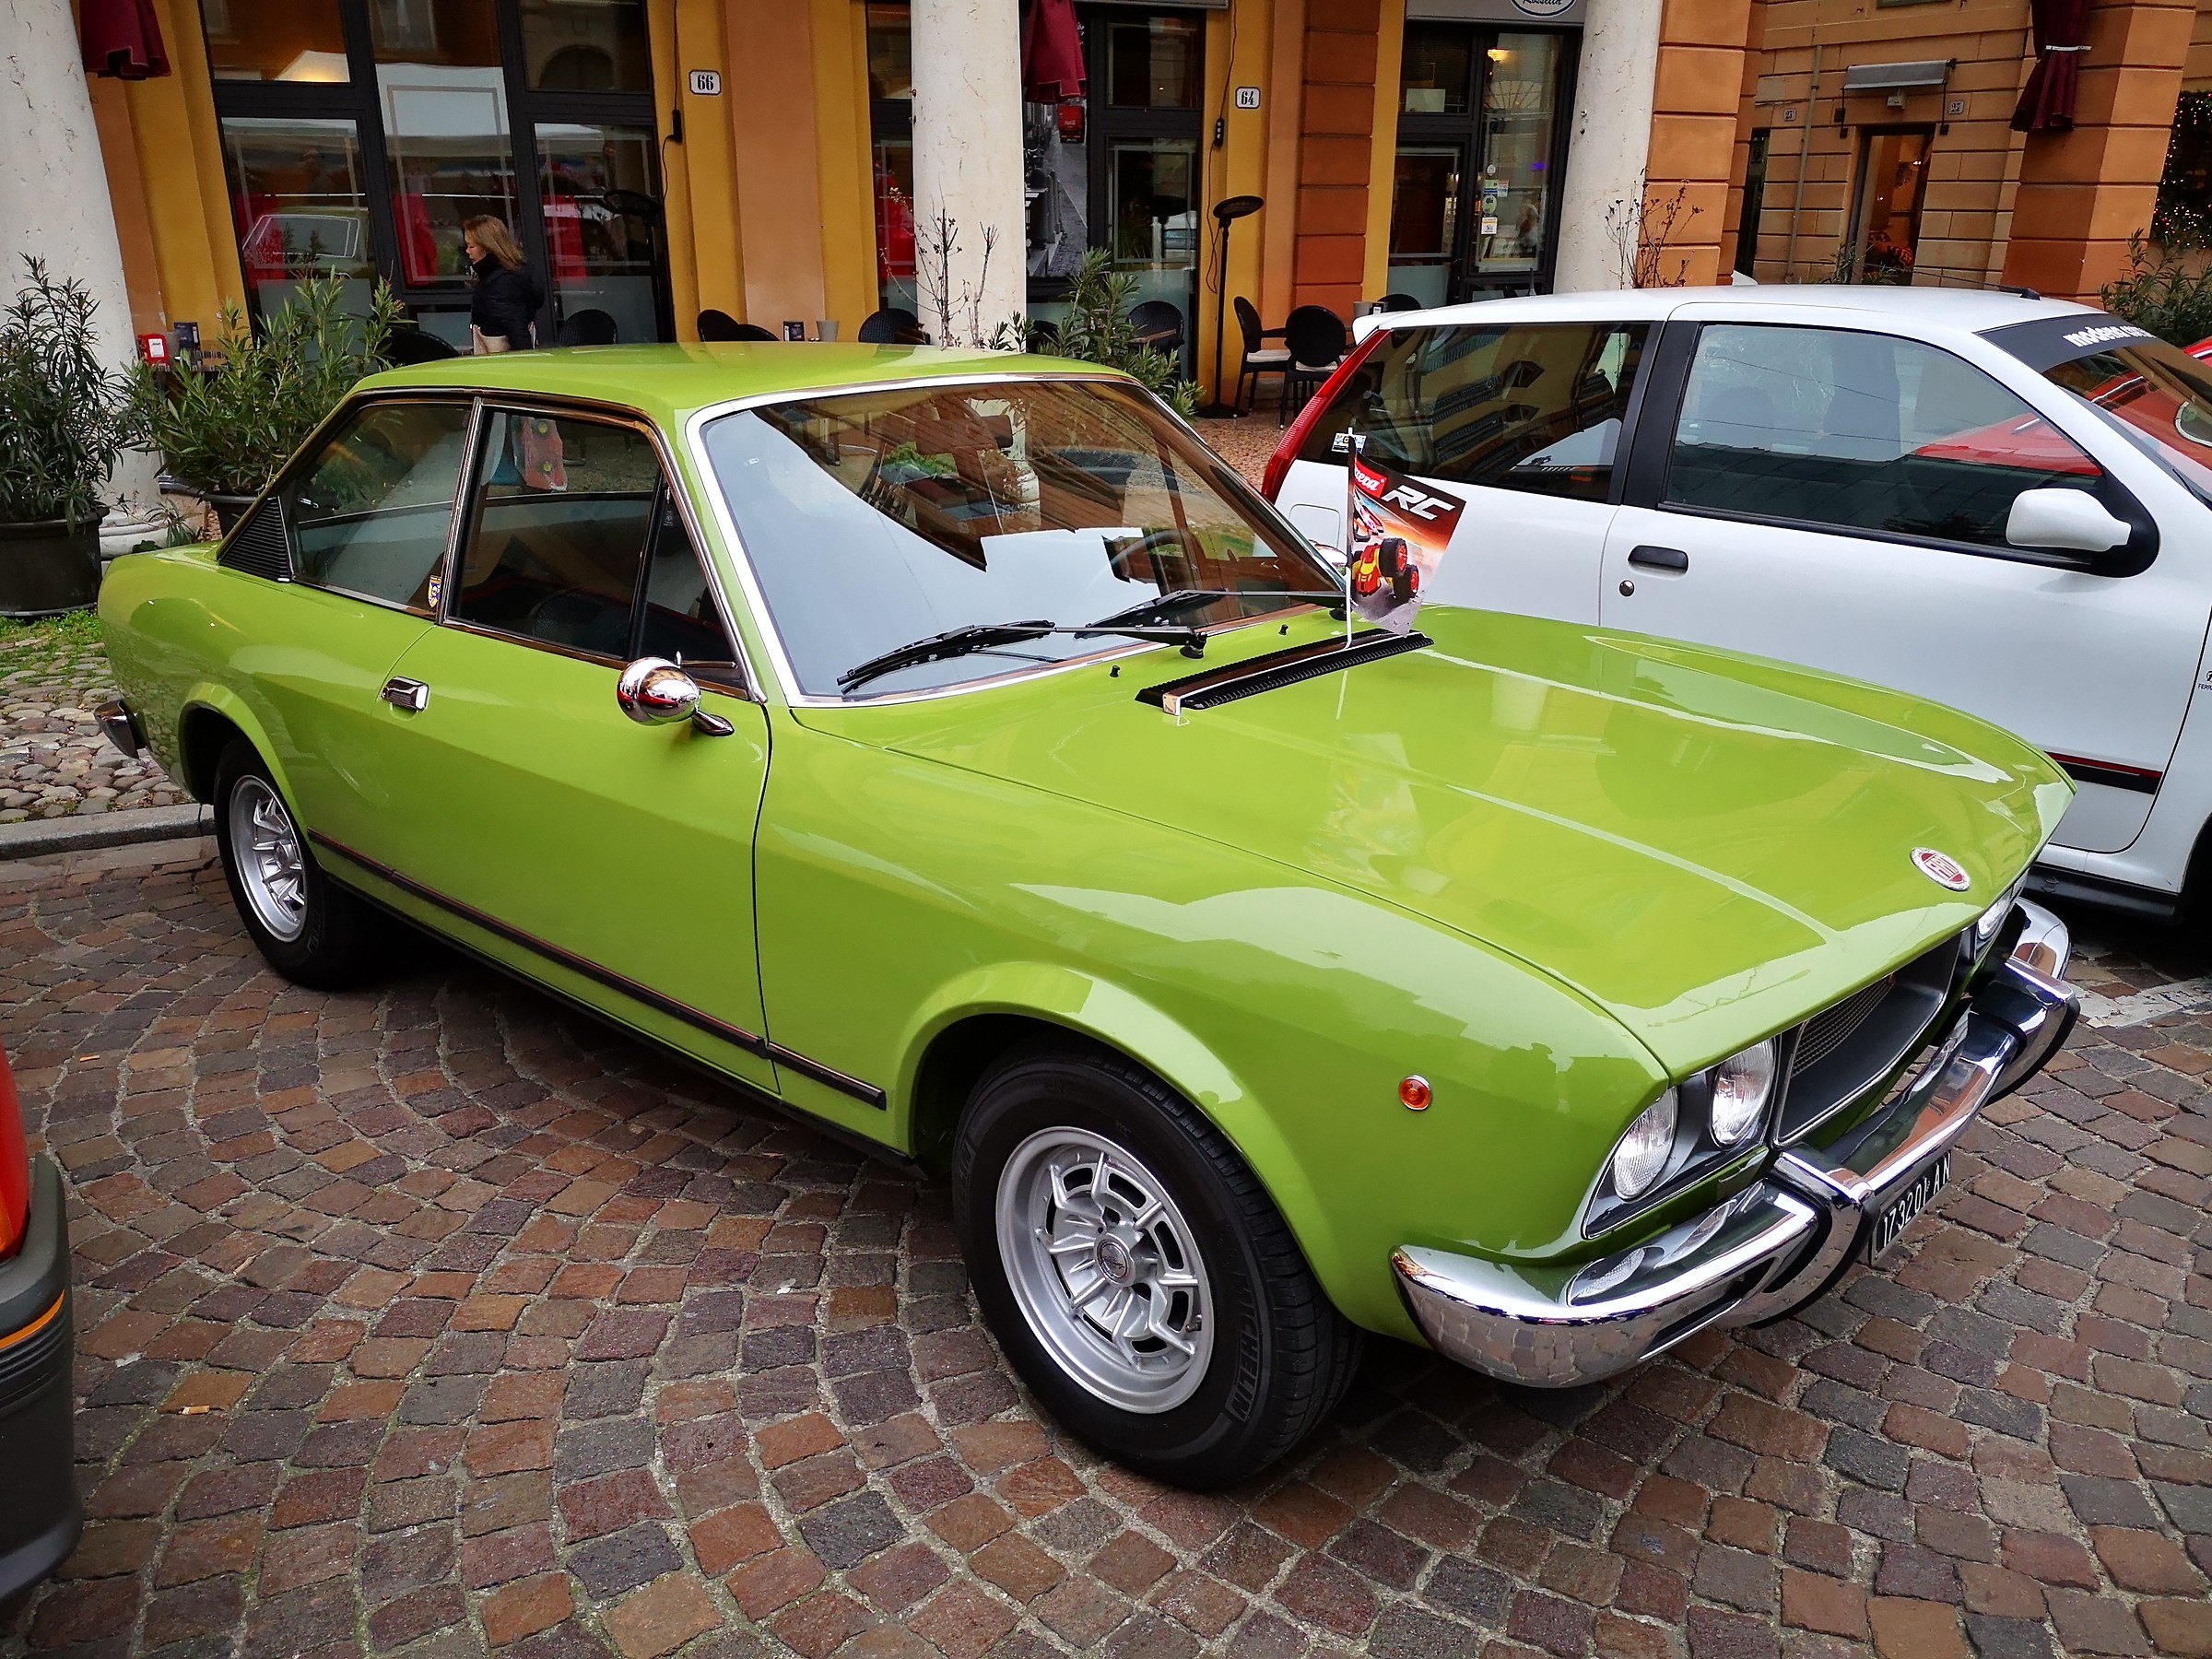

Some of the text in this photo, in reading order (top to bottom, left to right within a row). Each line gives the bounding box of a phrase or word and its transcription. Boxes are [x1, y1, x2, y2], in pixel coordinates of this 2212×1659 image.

[698, 75, 714, 90] 66
[1241, 91, 1253, 105] 64
[2062, 326, 2131, 347] modena
[1382, 485, 1455, 520] RC
[1924, 854, 1959, 881] FIAT
[1883, 1151, 1951, 1247] 173201 AN
[1230, 1272, 1260, 1419] MICHELIN
